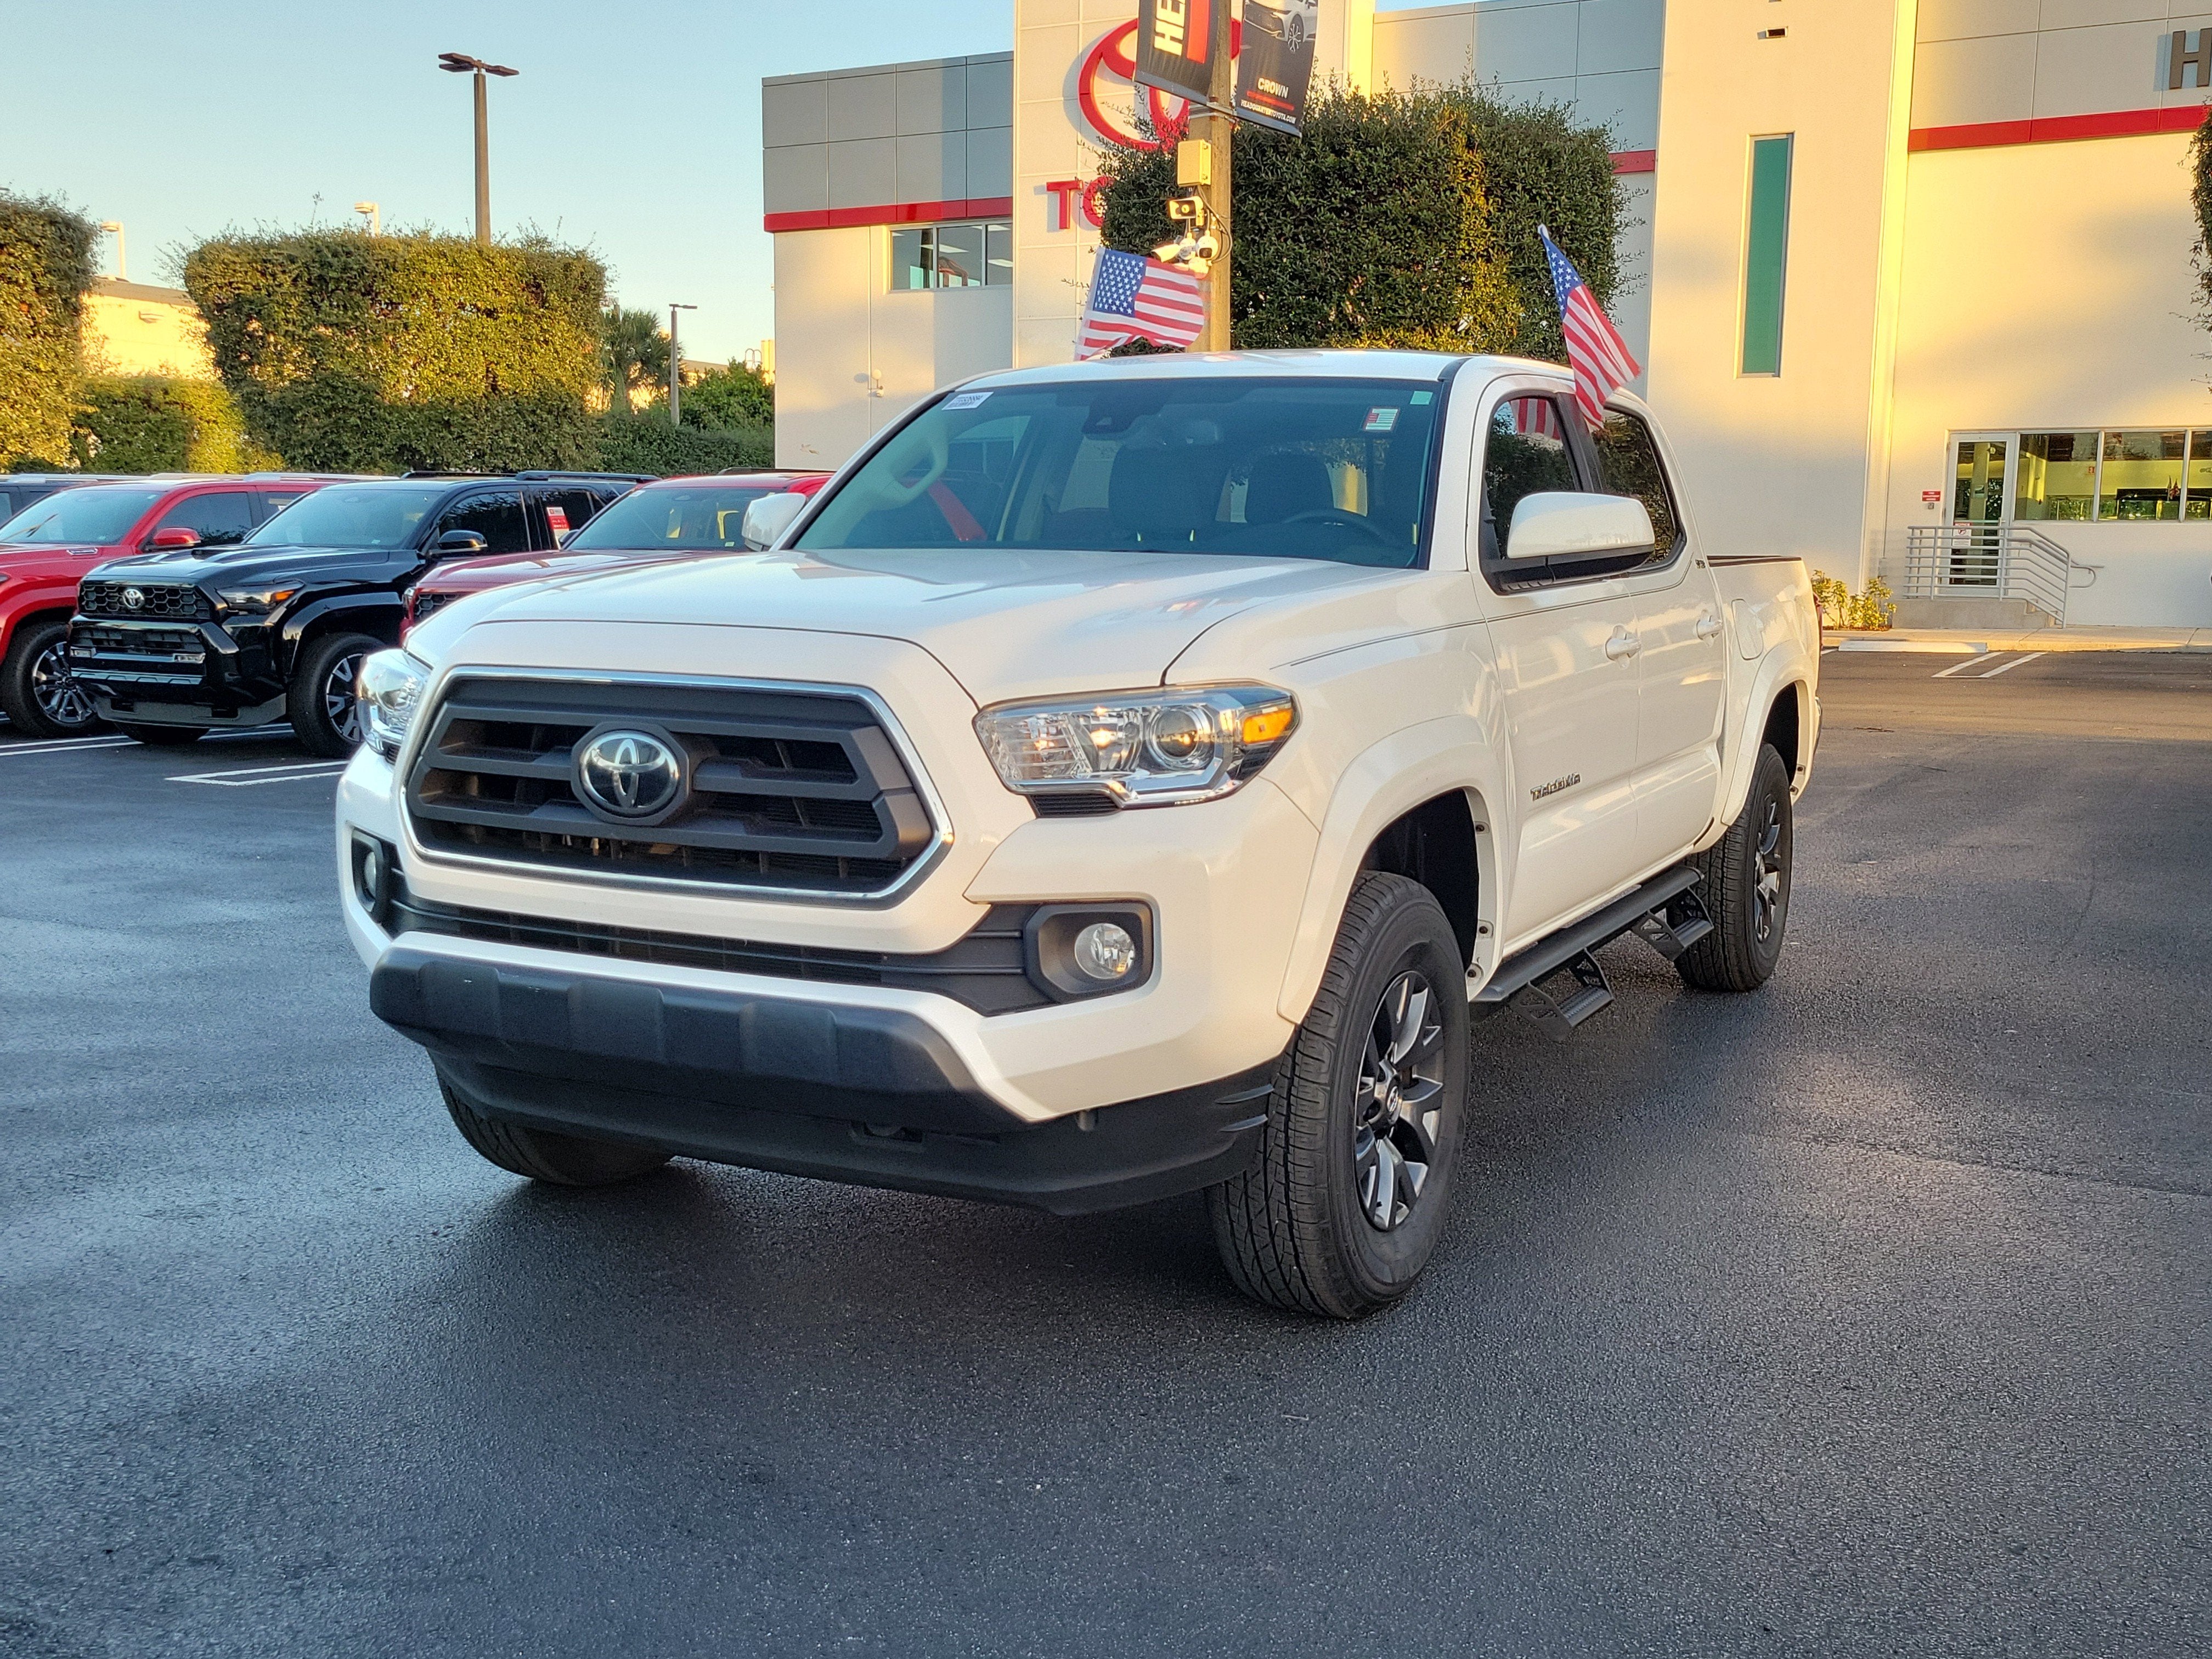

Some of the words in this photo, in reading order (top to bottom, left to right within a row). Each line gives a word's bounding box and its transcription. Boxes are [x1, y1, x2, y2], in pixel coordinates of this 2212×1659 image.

[1154, 0, 1186, 56] HE
[2169, 27, 2212, 89] H
[1257, 77, 1289, 99] CROWN
[1530, 771, 1581, 802] TACOMA
